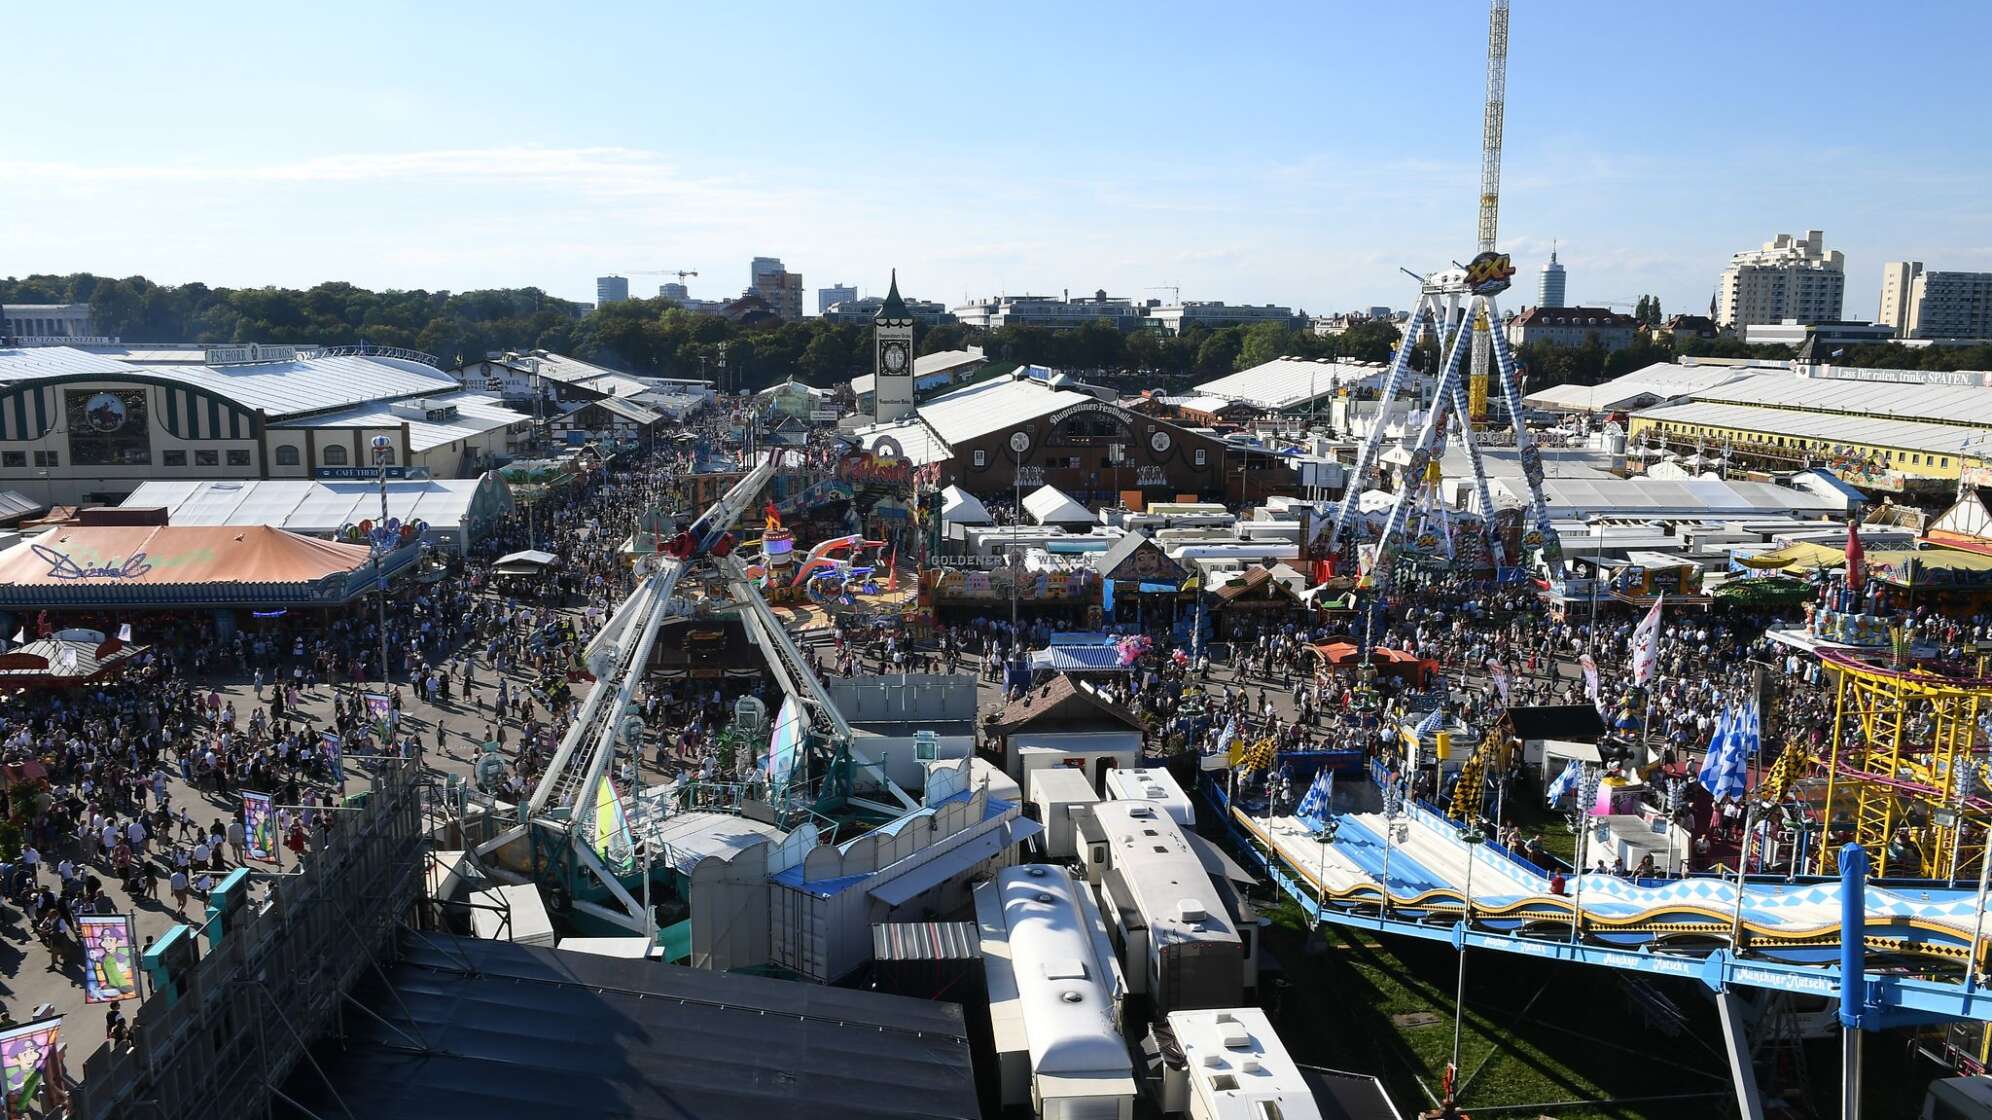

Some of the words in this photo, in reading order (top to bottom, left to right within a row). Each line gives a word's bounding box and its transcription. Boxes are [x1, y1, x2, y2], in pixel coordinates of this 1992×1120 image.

[1464, 254, 1516, 284] XXL
[1857, 369, 1872, 379] Dir
[931, 555, 1001, 566] GOLDENER
